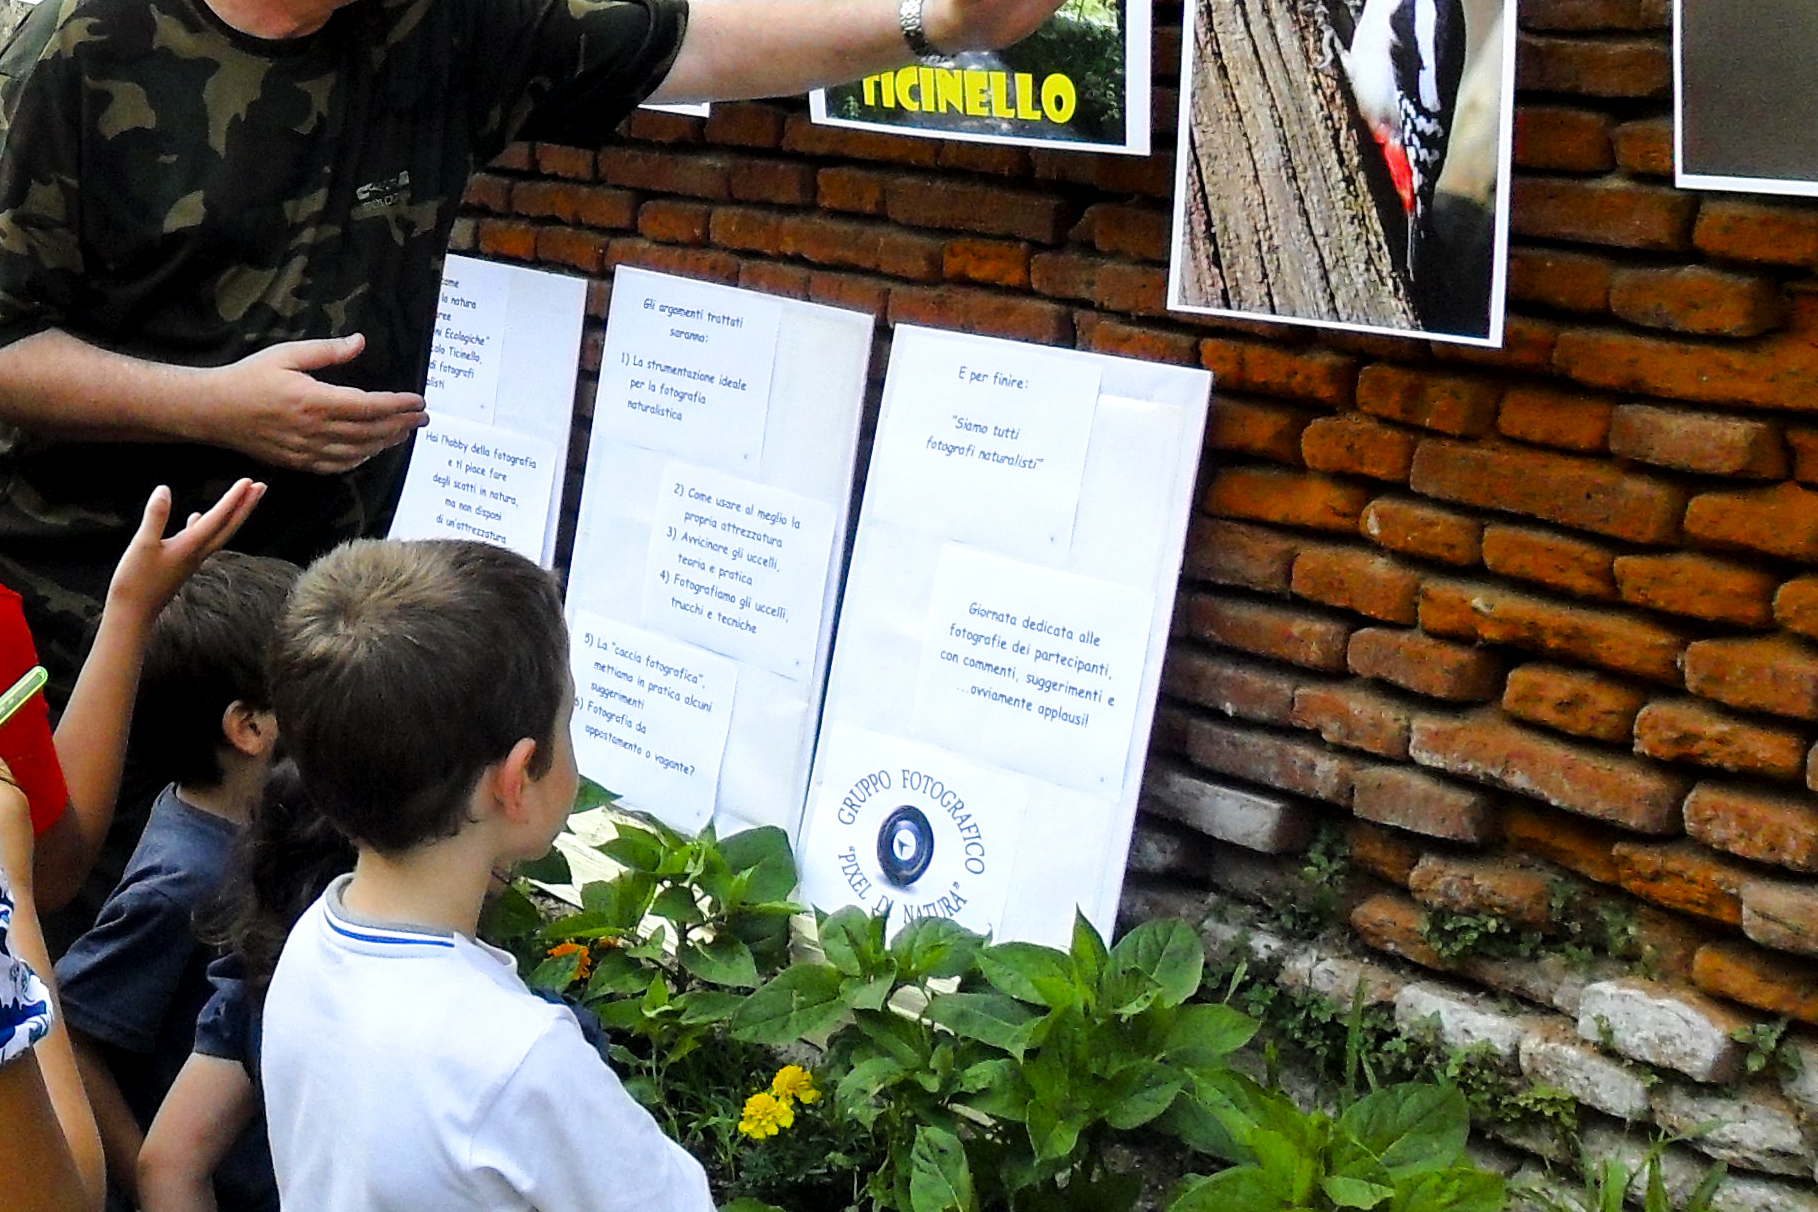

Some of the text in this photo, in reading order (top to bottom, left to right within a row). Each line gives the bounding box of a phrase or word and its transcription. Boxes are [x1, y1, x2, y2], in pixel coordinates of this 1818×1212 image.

[862, 66, 1076, 124] TICINELLO
[451, 296, 476, 309] natura
[644, 298, 743, 328] Gli argomenti trattati
[670, 328, 708, 343] saranno:
[440, 361, 474, 378] fotografi
[621, 352, 747, 391] 1) La strumentazione ideale
[959, 366, 1029, 389] E per finire:
[630, 379, 706, 404] per la fotografia
[627, 400, 682, 420] naturalistica
[953, 415, 1020, 440] "Siamo tutti
[425, 431, 536, 469] Hai l'hobby della fotografia
[926, 436, 975, 457] fotografi
[433, 473, 450, 487] degli
[454, 481, 476, 493] scatti
[480, 486, 486, 496] in
[456, 460, 462, 469] ti
[465, 463, 485, 476] piace
[490, 468, 507, 481] fare
[437, 514, 443, 524] di
[445, 499, 455, 508] ma
[459, 503, 472, 512] non
[674, 483, 800, 529] 2) Come usare al meglio la
[666, 526, 676, 541] 3)
[681, 532, 728, 554] Avvicinare
[732, 547, 743, 560] gli
[684, 511, 782, 548] propria attrezzatura
[678, 554, 753, 585] teoria e pratica
[660, 570, 670, 584] 4)
[674, 574, 736, 603] Fotografiamo
[739, 597, 751, 609] gli
[671, 597, 756, 634] trucchi e tecniche
[969, 602, 1100, 647] Giornata dedicata alle
[584, 633, 593, 648] 5)
[597, 638, 607, 650] La
[612, 642, 641, 663] "caccia
[950, 622, 1112, 680] fotografie dei partecipanti,
[594, 662, 713, 712] mettiamo in pratica alcuni
[940, 650, 1114, 706] con commenti, suggerimenti e
[591, 682, 644, 710] suggerimenti
[587, 701, 632, 728] Fotografia
[636, 721, 646, 734] da
[1038, 704, 1089, 727] applausi!
[585, 724, 642, 754] appostamento
[655, 754, 695, 776] vagante?
[838, 769, 985, 875] GRUPPO FOTOGRAFICO
